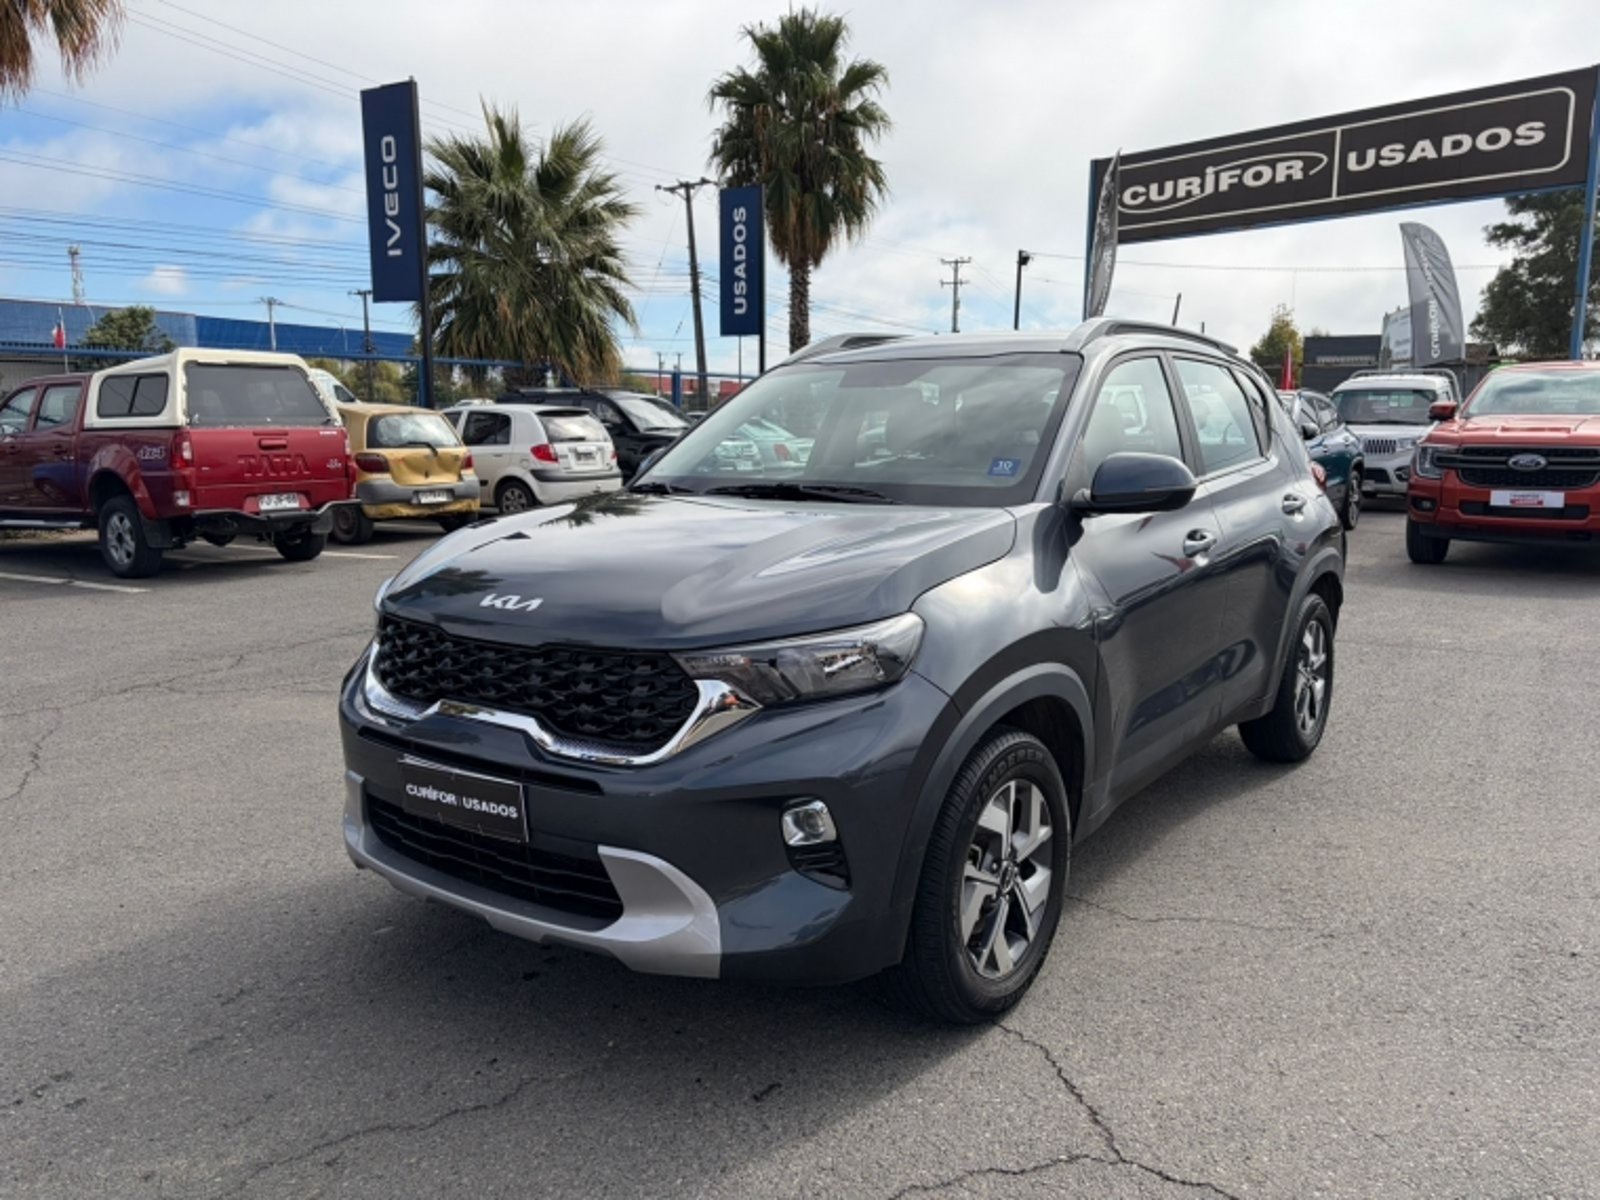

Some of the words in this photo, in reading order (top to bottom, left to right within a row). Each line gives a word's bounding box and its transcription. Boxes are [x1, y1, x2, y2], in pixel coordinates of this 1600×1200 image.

[1346, 121, 1546, 172] USADOS
[381, 134, 403, 257] IVECO
[732, 205, 748, 315] USADOS
[237, 454, 311, 477] TATA
[479, 593, 544, 612] KIA
[462, 796, 519, 820] USADOS
